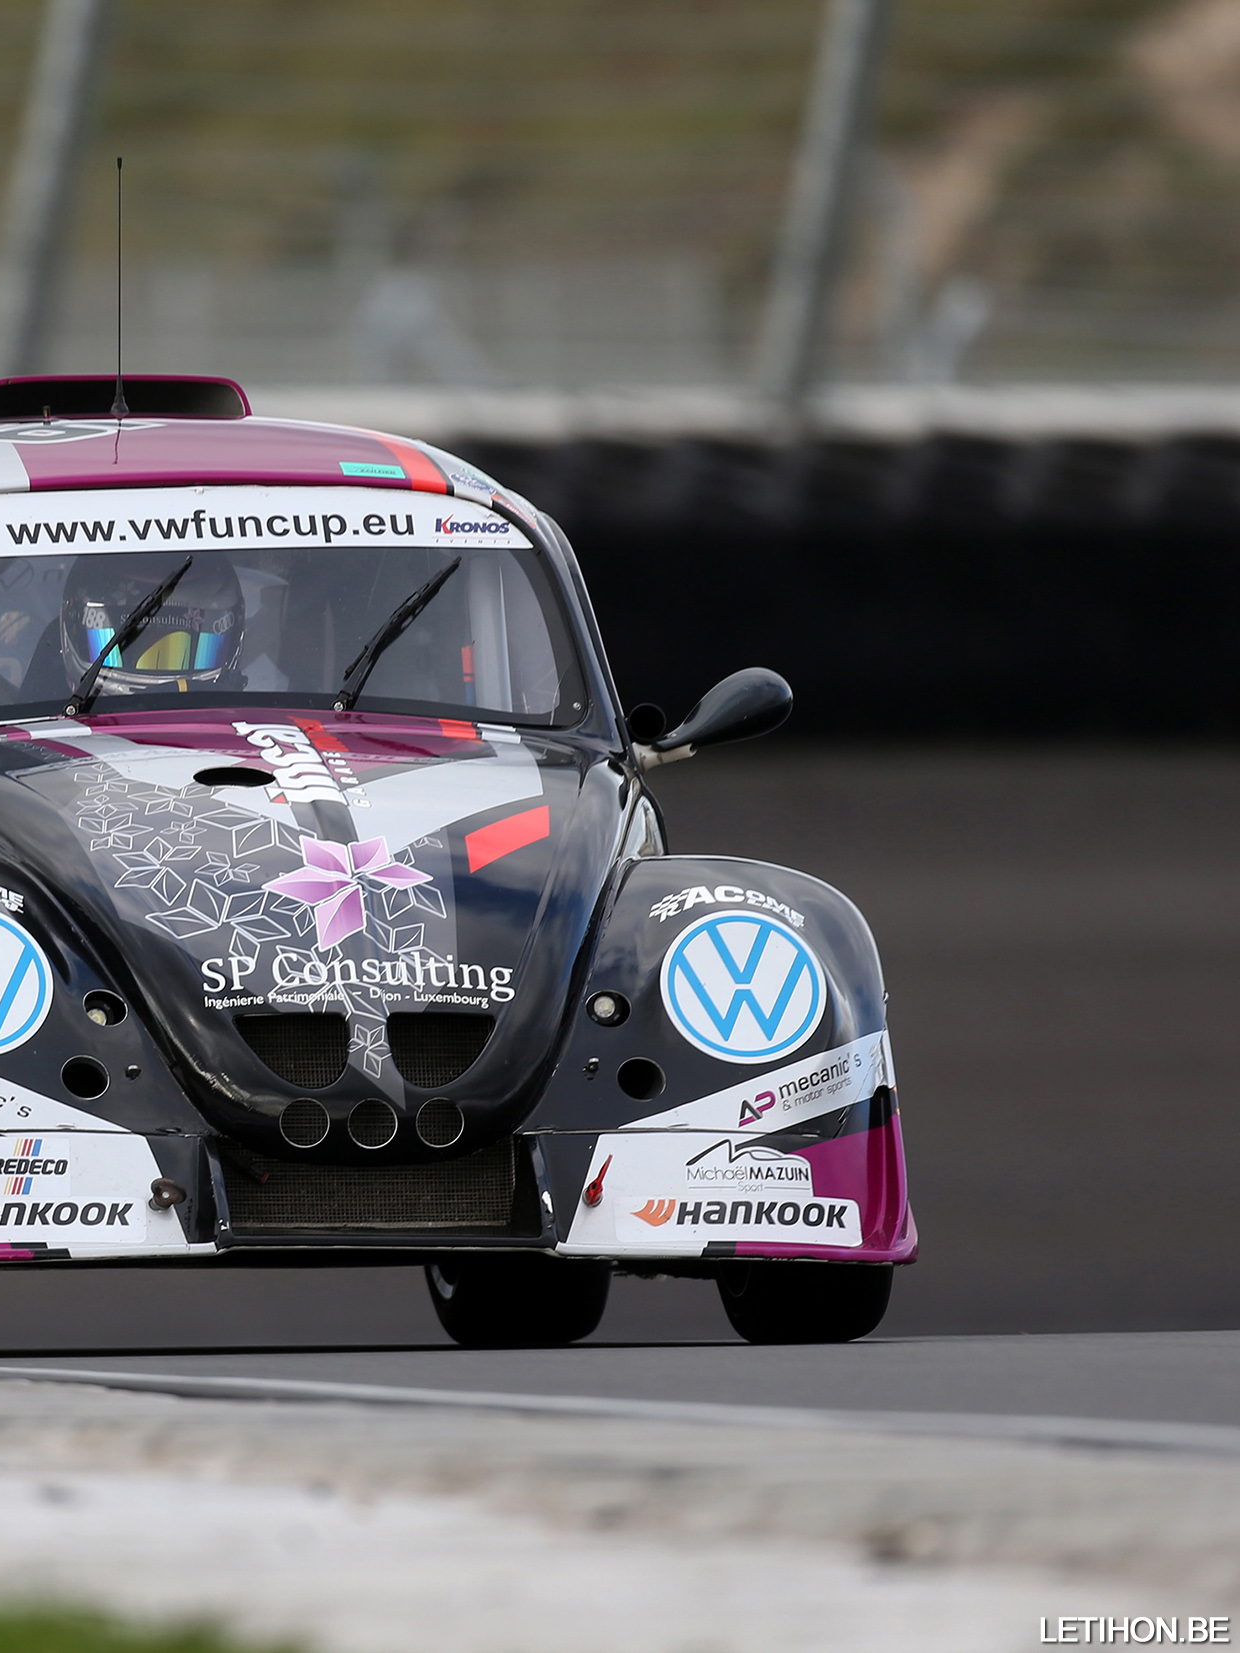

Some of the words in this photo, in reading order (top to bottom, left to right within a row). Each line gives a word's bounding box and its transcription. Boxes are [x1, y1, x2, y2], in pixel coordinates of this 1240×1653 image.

[6, 509, 415, 545] www.vwfuncup.eu
[434, 514, 511, 534] KRONOS
[201, 956, 257, 992] SP
[272, 950, 516, 1003] Consulting
[204, 993, 264, 1009] Ingénierie
[268, 990, 345, 1004] Patrimoniale
[370, 987, 402, 1002] Dijon
[414, 990, 489, 1009] Luxembourg
[738, 1090, 776, 1128] AP
[782, 1100, 792, 1111] &
[794, 1088, 824, 1107] motor
[827, 1076, 852, 1095] sports
[738, 1182, 764, 1193] Sport
